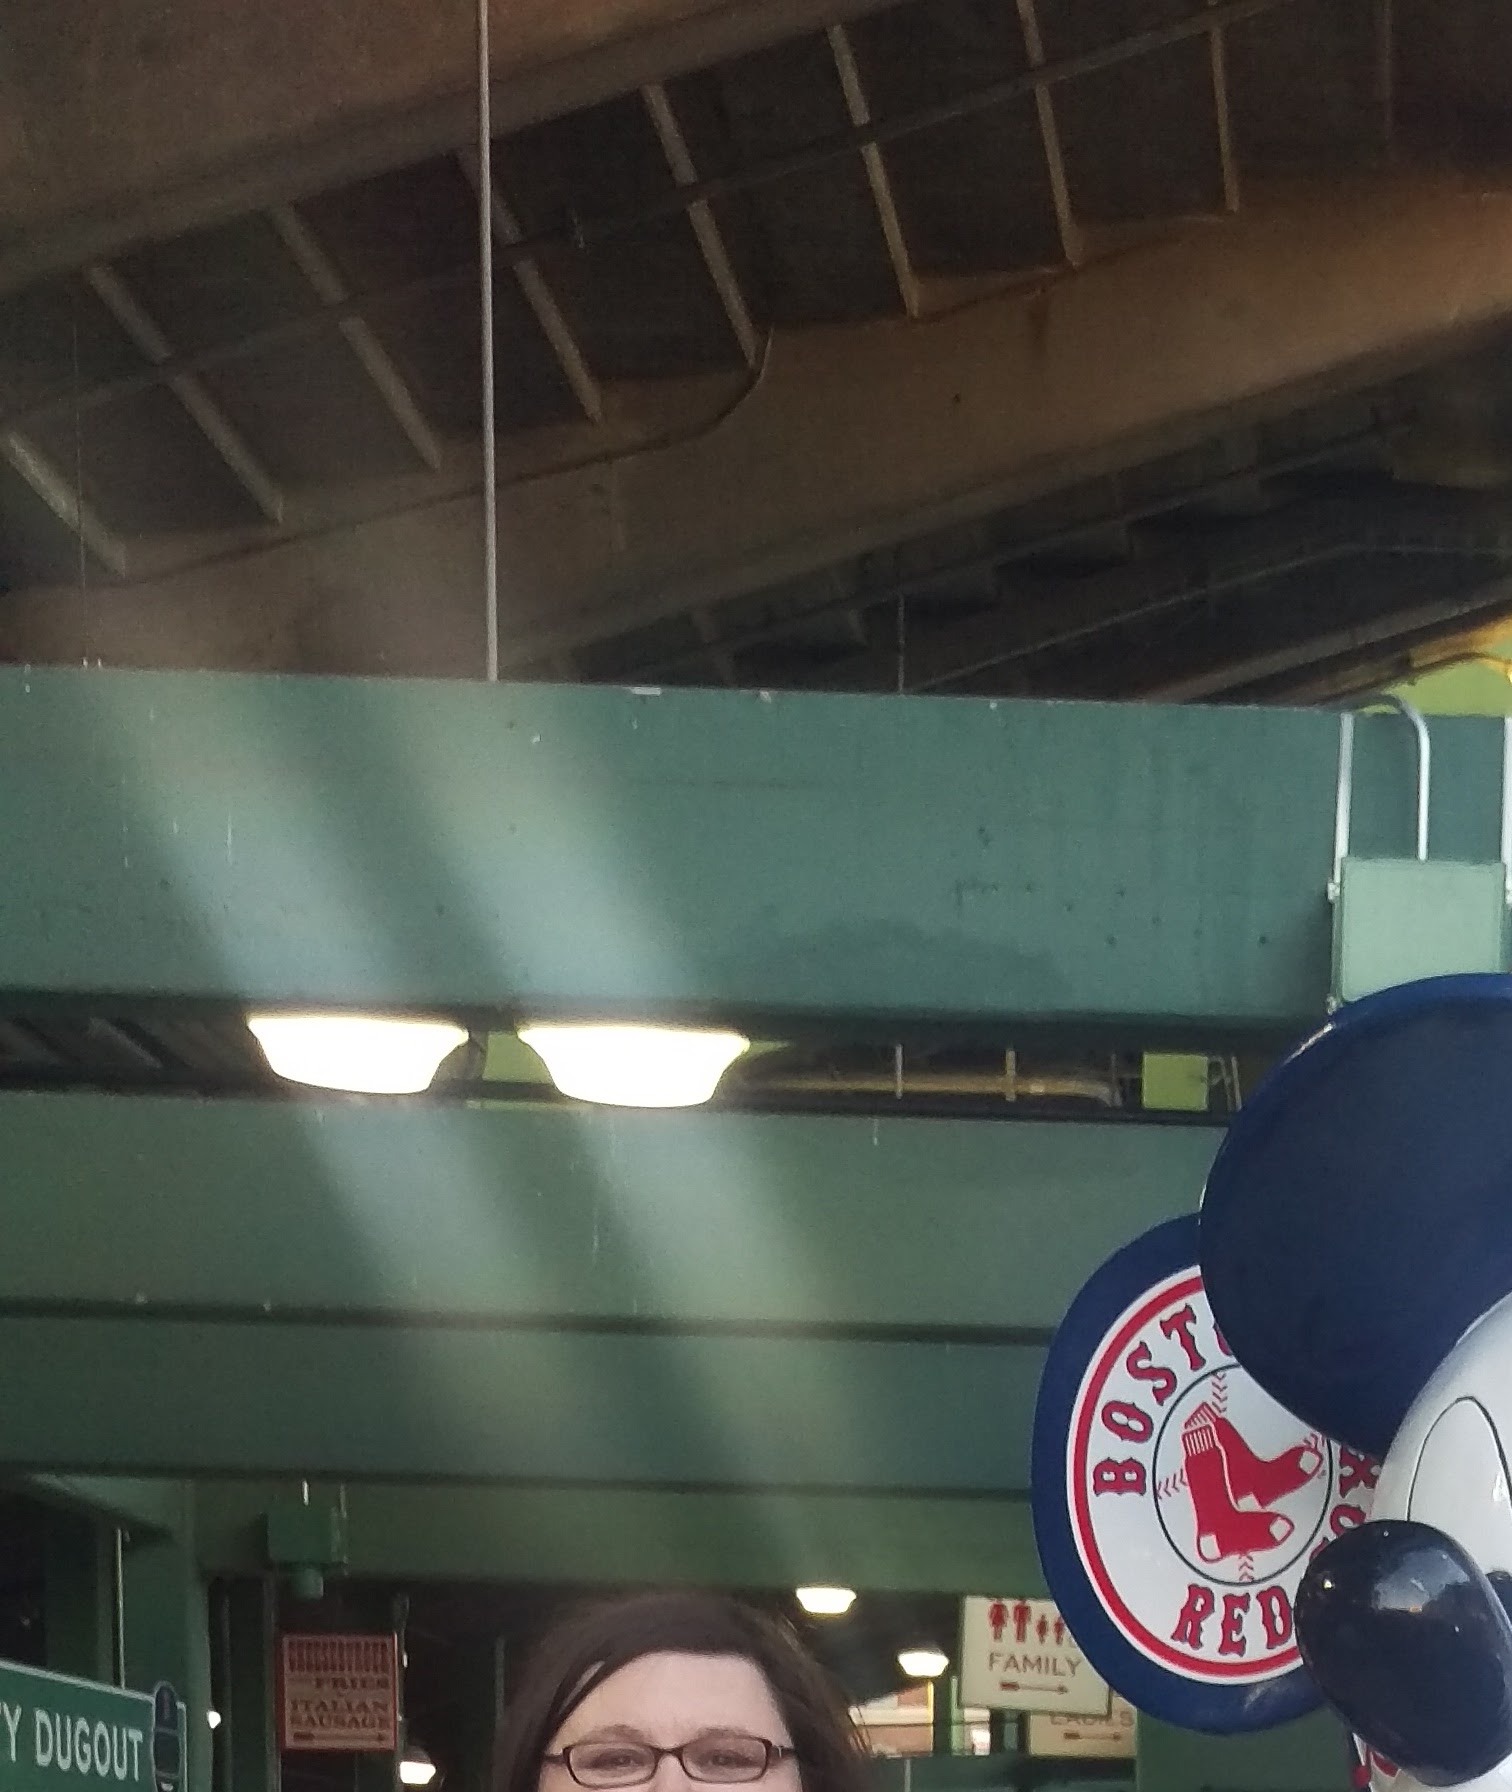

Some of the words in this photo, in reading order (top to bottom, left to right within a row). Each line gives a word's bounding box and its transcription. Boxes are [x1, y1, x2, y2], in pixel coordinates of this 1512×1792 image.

[1093, 1303, 1233, 1497] BOST
[1171, 1583, 1293, 1657] RED
[1309, 1444, 1379, 1563] OX
[988, 1652, 1082, 1677] FAMILY
[0, 1702, 22, 1763] Y
[35, 1706, 143, 1782] DUGOUT
